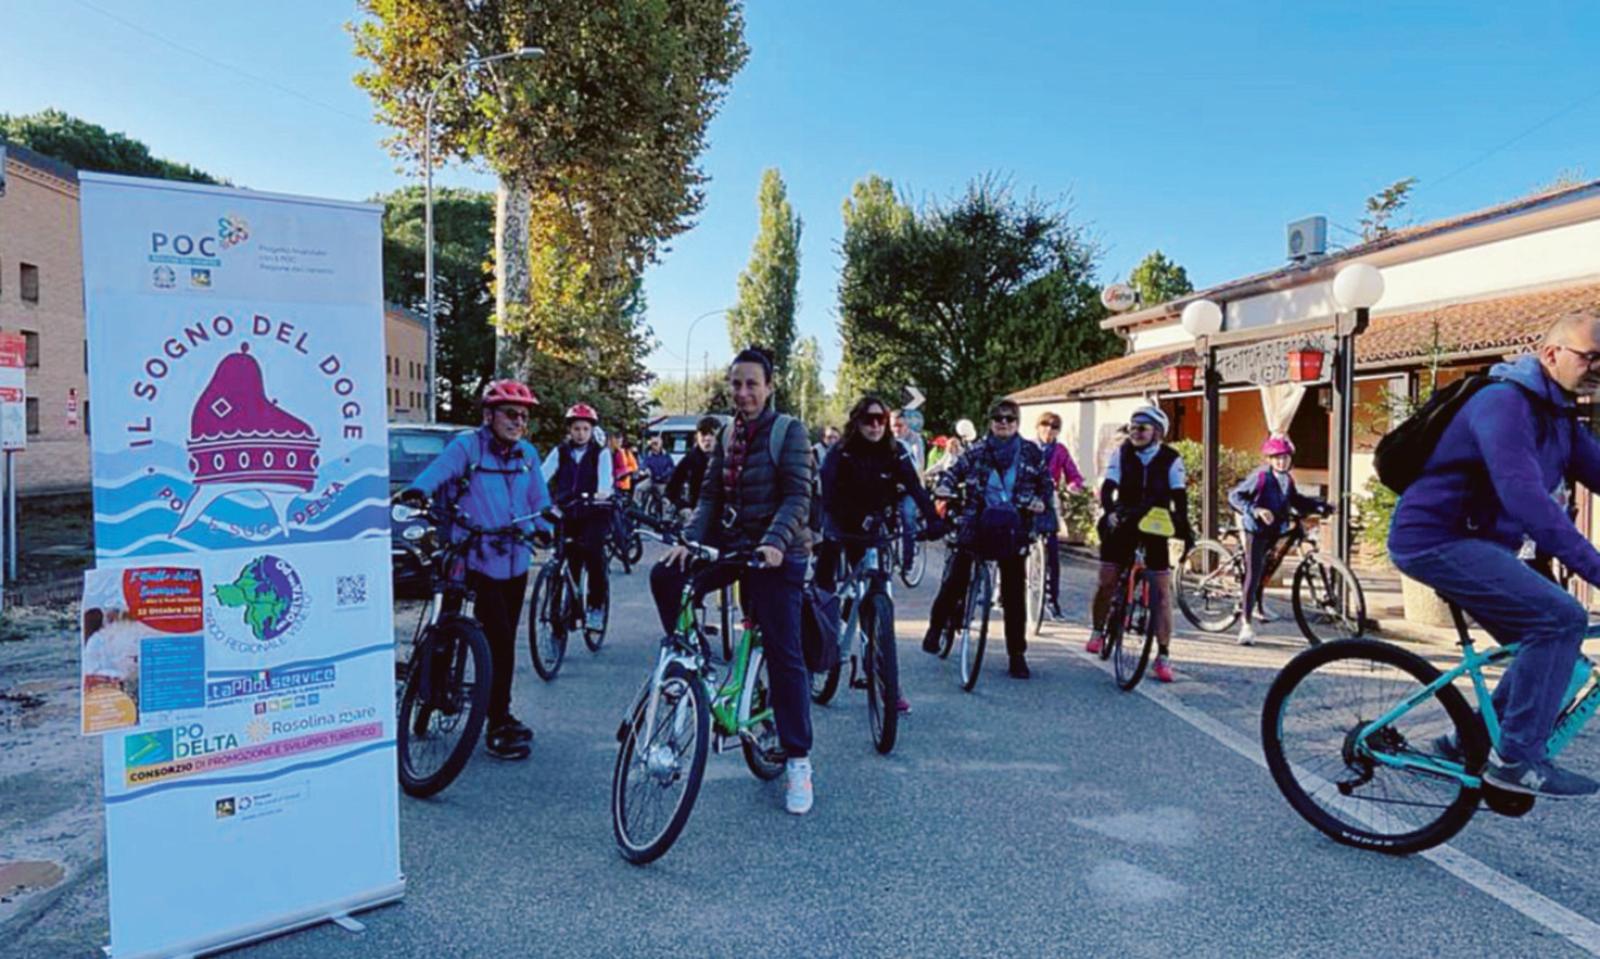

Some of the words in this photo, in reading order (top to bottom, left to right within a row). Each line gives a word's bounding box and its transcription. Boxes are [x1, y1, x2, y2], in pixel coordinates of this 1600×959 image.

[152, 232, 216, 257] POC
[252, 314, 310, 355] DEL
[134, 315, 234, 402] SOGNO
[319, 354, 363, 440] DOGE
[128, 416, 153, 447] IL
[158, 485, 184, 512] PO
[294, 482, 345, 525] DELTA
[175, 723, 204, 741] PO
[272, 712, 336, 735] Rosolina
[338, 706, 377, 723] mare
[130, 762, 193, 782] CONSORZIO
[195, 759, 206, 770] DI
[207, 748, 274, 767] PROMOZIONE
[283, 734, 329, 753] SVILUPPO
[175, 733, 238, 758] DELTA
